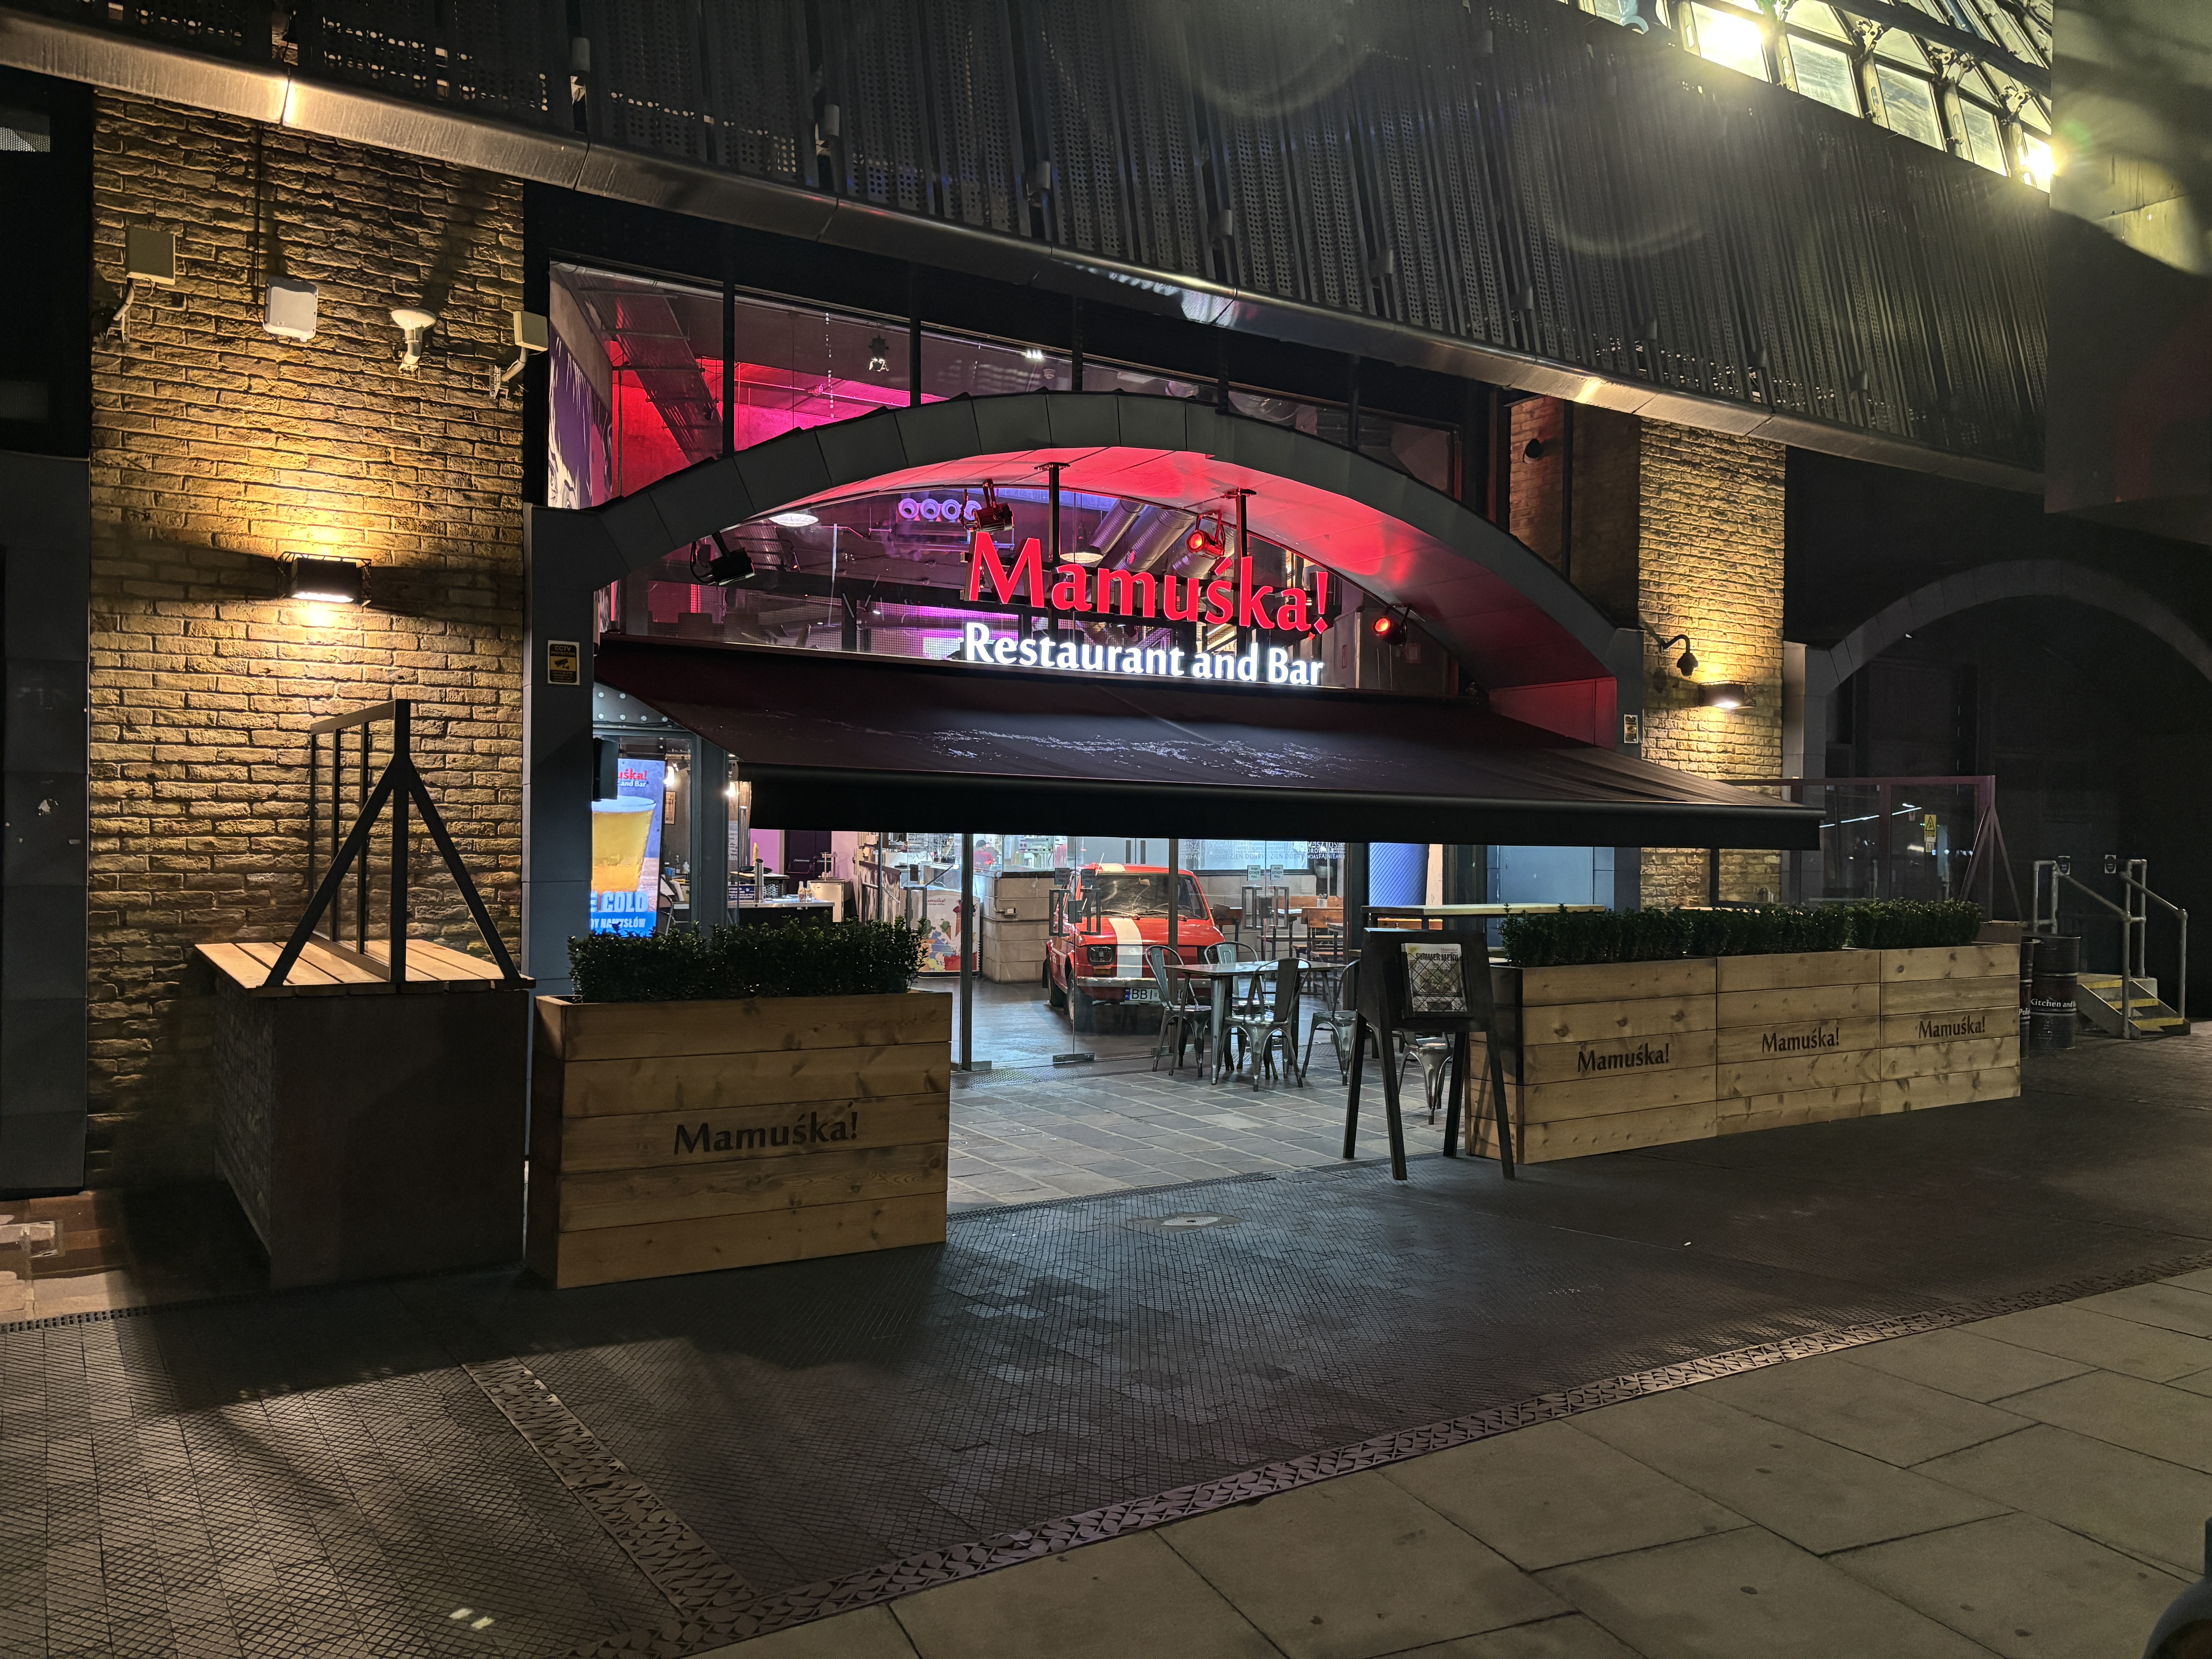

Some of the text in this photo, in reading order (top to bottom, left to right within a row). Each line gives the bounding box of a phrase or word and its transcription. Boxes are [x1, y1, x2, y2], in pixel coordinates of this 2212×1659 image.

[969, 531, 1328, 634] Mamuśka!
[965, 622, 1324, 685] Restaurant and Bar
[618, 768, 647, 780] uśka!
[601, 891, 648, 912] COLD
[1416, 953, 1458, 962] SUMMER MENU
[1762, 1027, 1839, 1053] Mamuśka!
[1919, 1015, 1985, 1039] Mamuśka!
[1578, 1042, 1669, 1072] Mamuśka!
[673, 1111, 857, 1155] Mamuśka!
